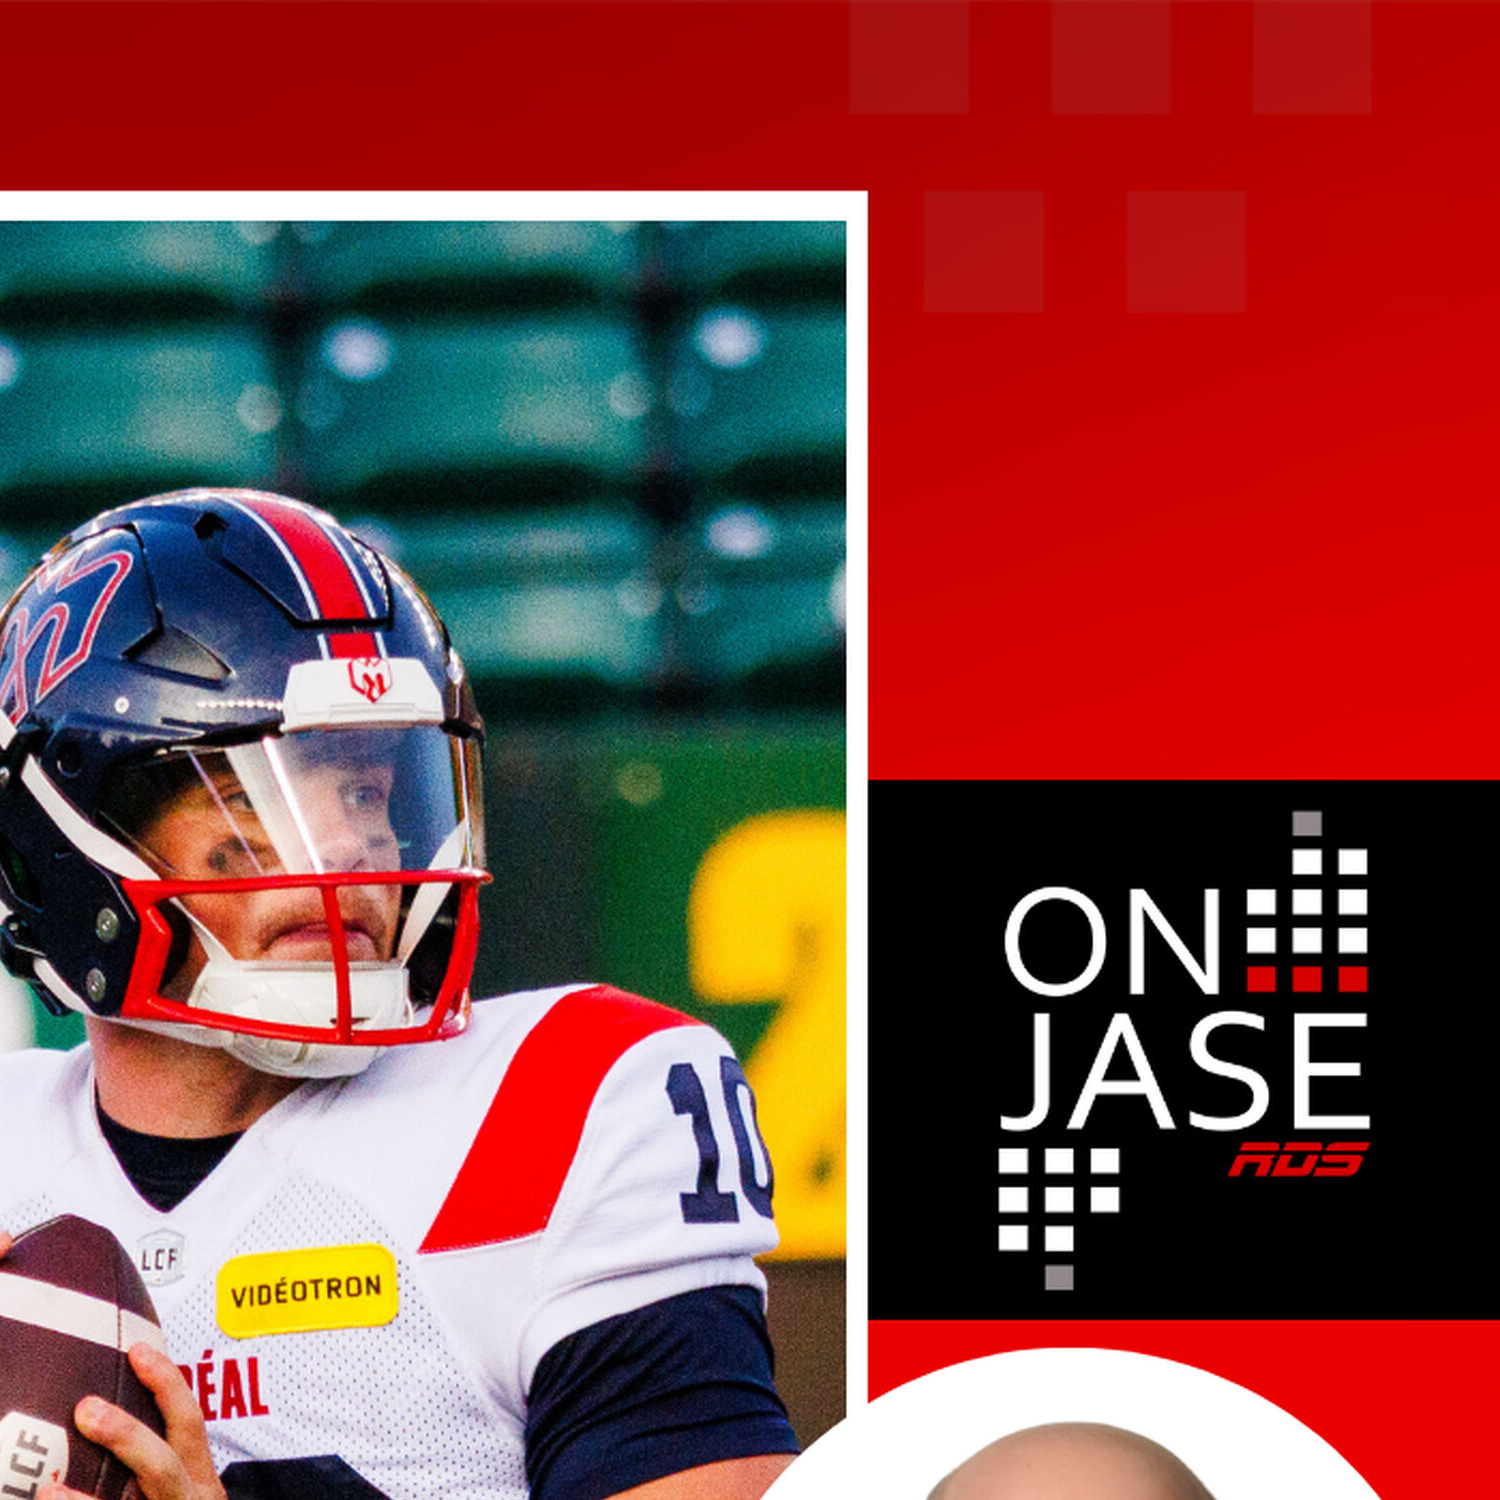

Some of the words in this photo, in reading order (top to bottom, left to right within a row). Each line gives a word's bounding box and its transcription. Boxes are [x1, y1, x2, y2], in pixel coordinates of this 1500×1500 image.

[665, 1055, 776, 1224] 10
[141, 1247, 178, 1271] LCF
[230, 1274, 382, 1308] VIDÉOTRON
